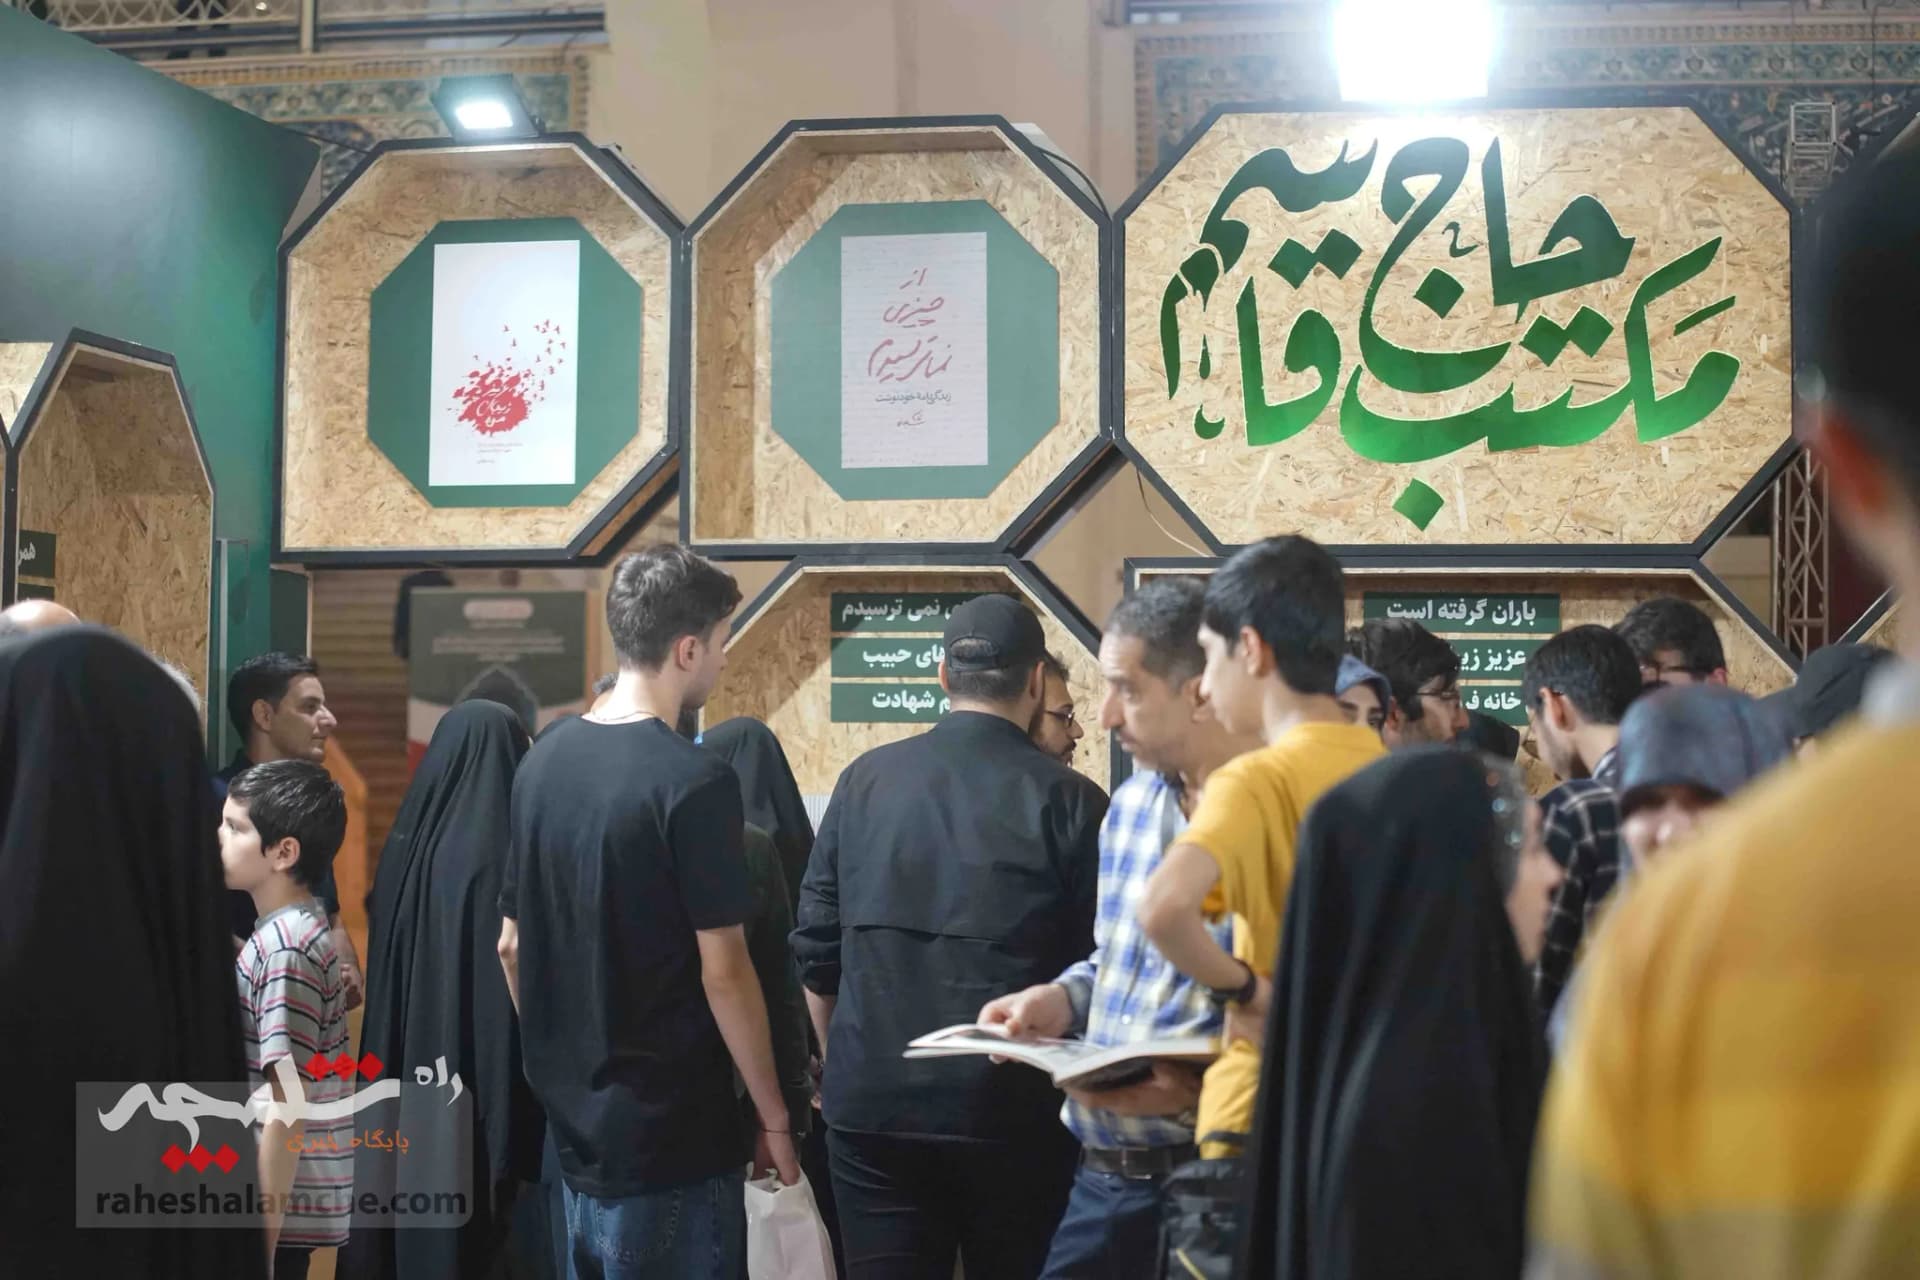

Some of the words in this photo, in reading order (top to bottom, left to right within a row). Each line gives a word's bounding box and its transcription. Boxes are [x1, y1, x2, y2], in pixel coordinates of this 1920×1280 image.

[1358, 136, 1636, 393] حاج
[899, 267, 928, 290] از
[1159, 136, 1378, 446] قاسم
[883, 296, 945, 328] چیزی
[1340, 236, 1740, 531] مکتب
[841, 598, 904, 624] ترسیدم
[906, 598, 941, 622] نمی
[1386, 600, 1433, 619] است
[1437, 598, 1487, 625] گرفته
[1491, 600, 1537, 626] باران
[862, 649, 912, 668] حبیب
[1484, 648, 1527, 672] عزیز
[872, 689, 936, 714] شهادت
[1483, 690, 1522, 710] خانه
